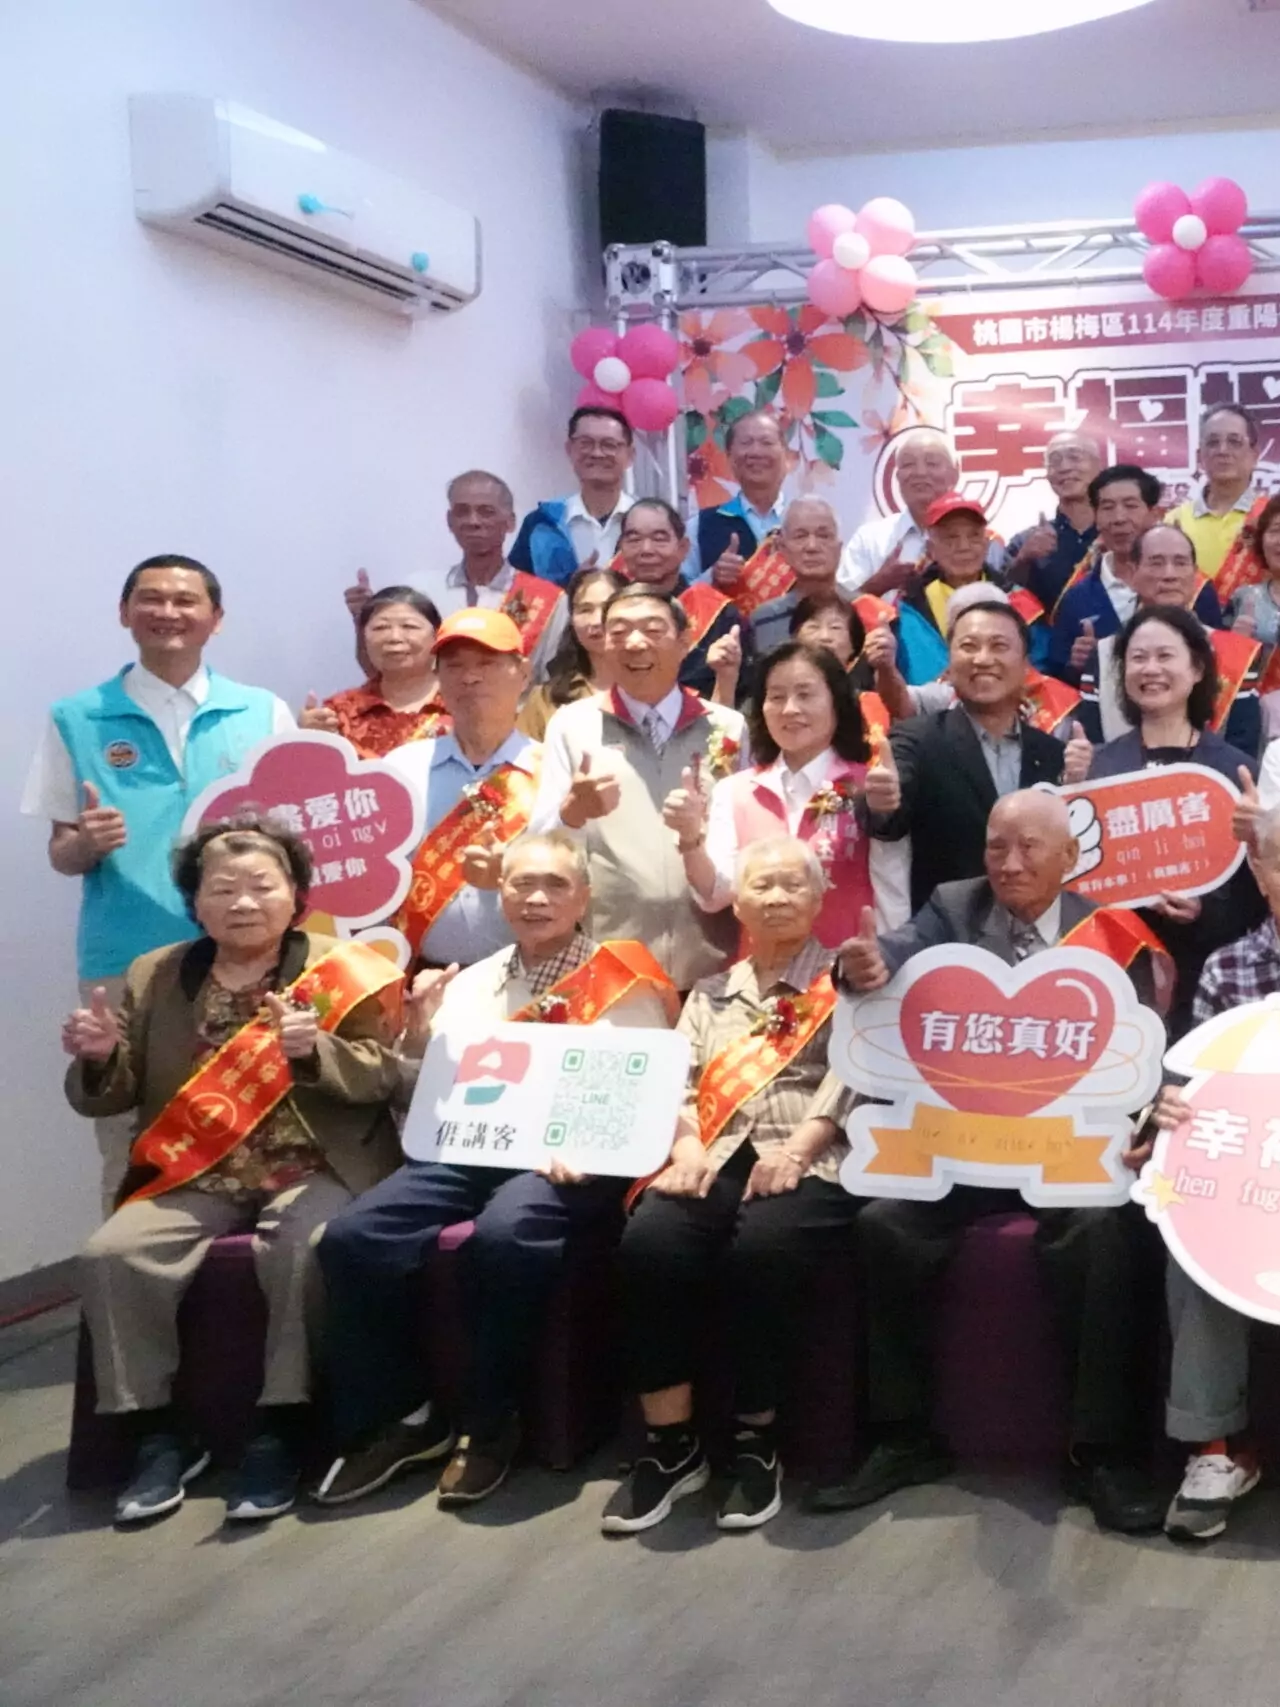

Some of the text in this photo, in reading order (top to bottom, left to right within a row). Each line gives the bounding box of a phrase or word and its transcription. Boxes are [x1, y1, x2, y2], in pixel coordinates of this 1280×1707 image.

[920, 1010, 1098, 1062] 有您真好
[581, 1092, 610, 1105] LINE
[1175, 1166, 1217, 1198] hen
